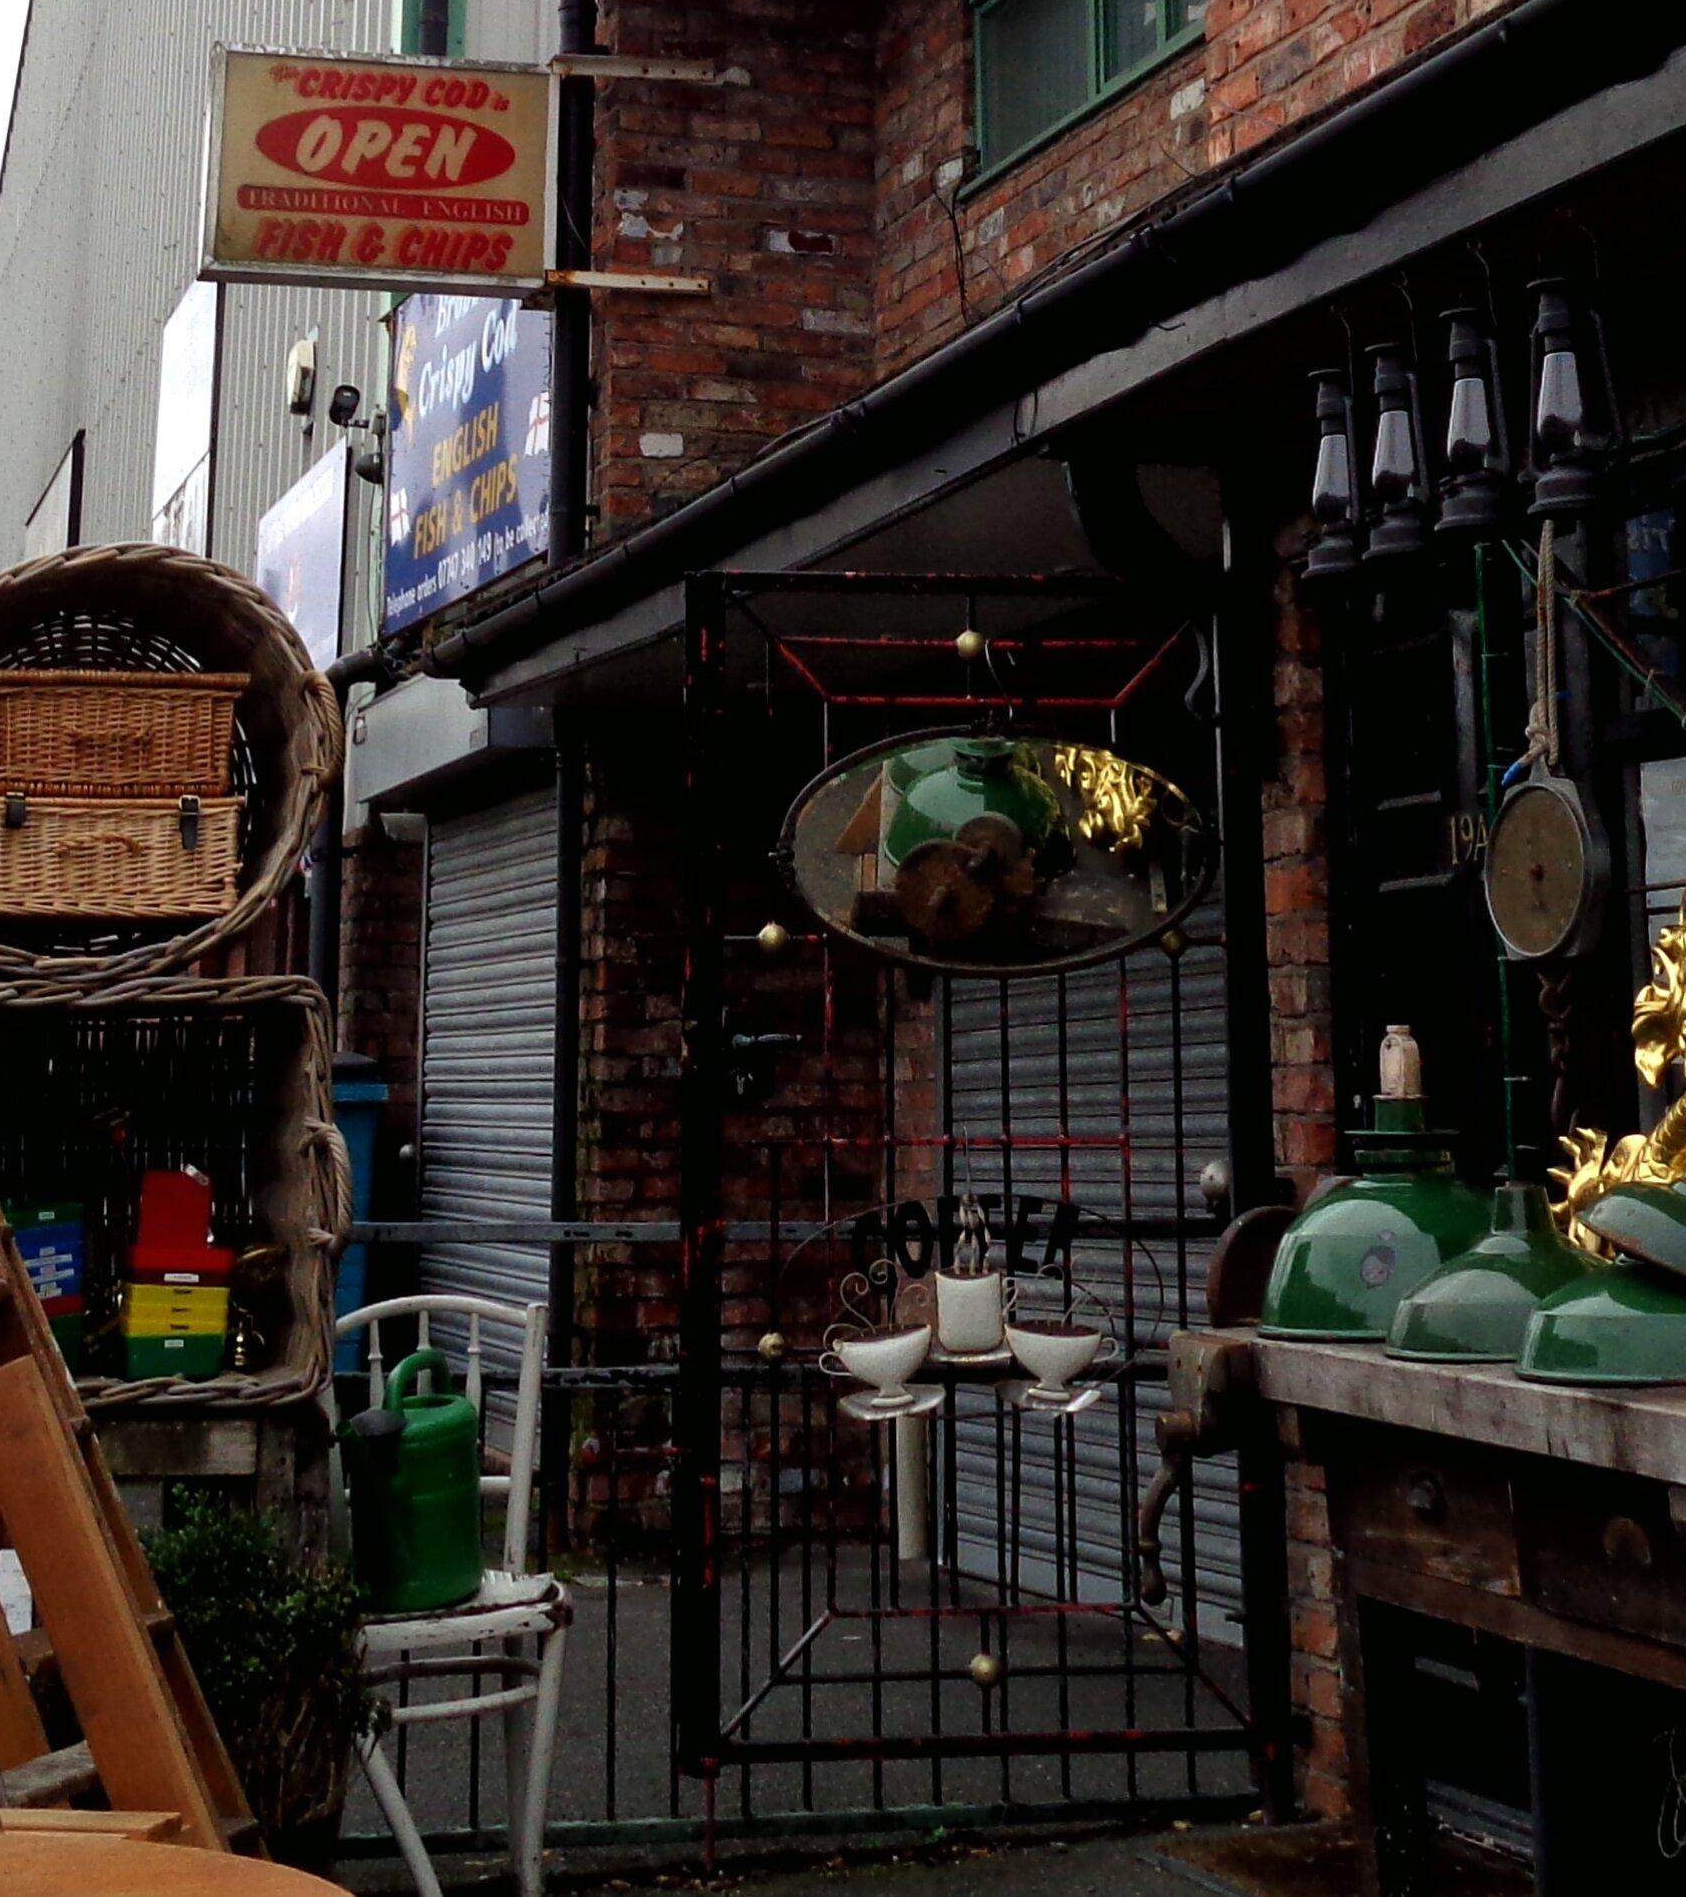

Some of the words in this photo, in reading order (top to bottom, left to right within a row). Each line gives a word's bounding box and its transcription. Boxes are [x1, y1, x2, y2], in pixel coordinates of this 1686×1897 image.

[295, 67, 417, 104] CRISPY
[423, 76, 490, 110] COD
[295, 114, 478, 182] OPEN
[249, 188, 406, 216] TRADITIONAL
[423, 201, 523, 222] ENGLISH
[253, 217, 347, 260] FISH
[395, 225, 514, 272] CHIPS
[418, 341, 477, 418] Crispy
[432, 401, 499, 487] ENGLISH
[415, 505, 448, 559] FISH
[470, 454, 519, 524] CHIPS
